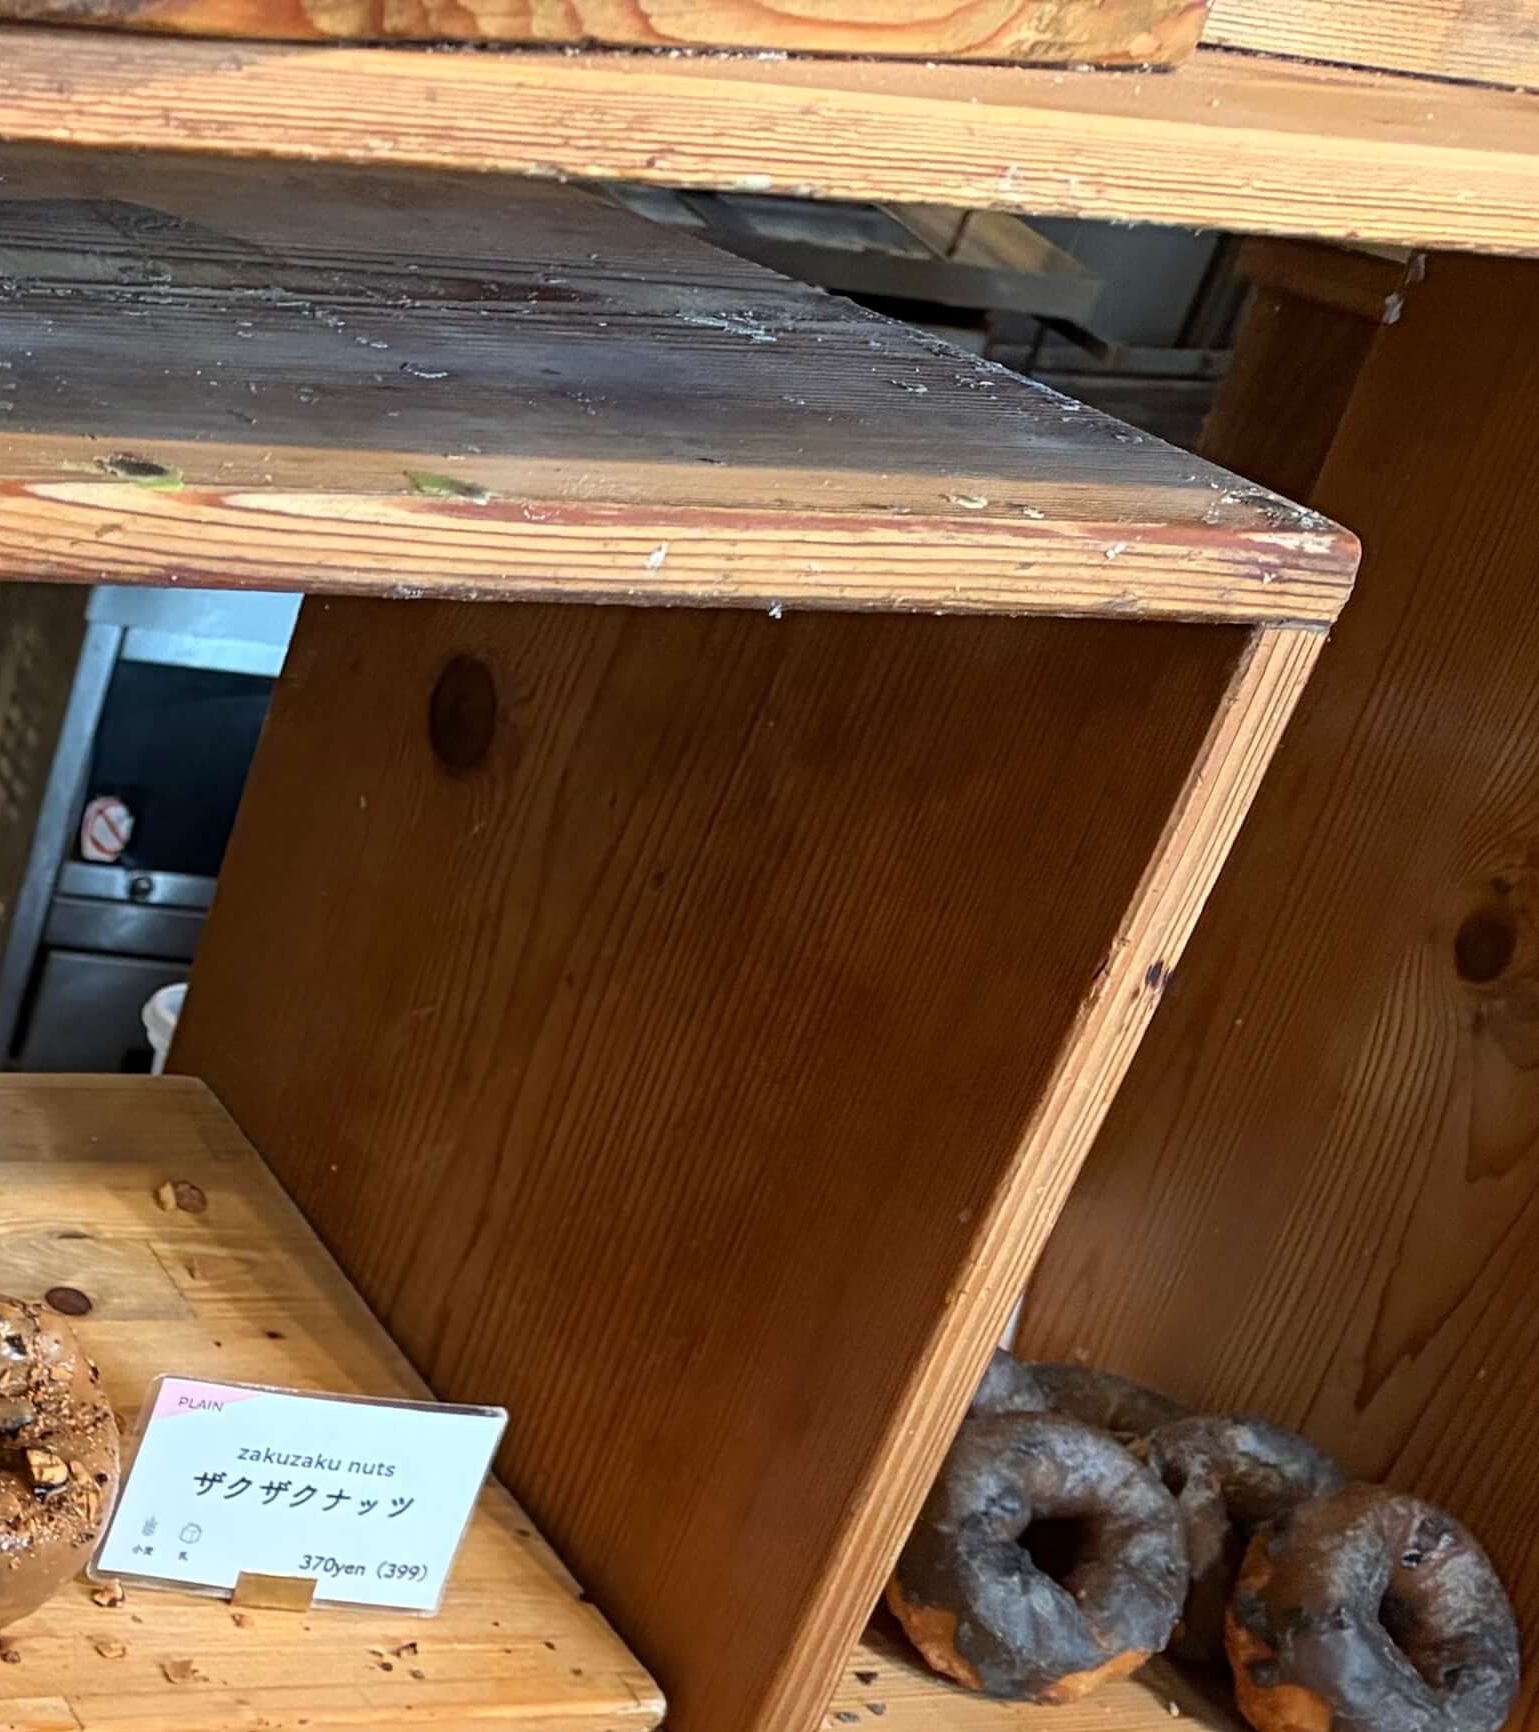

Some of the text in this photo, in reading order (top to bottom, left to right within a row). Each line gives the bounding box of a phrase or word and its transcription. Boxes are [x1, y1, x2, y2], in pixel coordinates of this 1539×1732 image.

[178, 1396, 225, 1413] PLAIN
[237, 1446, 397, 1478] zakuzaku nuts
[193, 1471, 416, 1519] ザクザクナッツ
[299, 1554, 429, 1582] 370yen (399)
